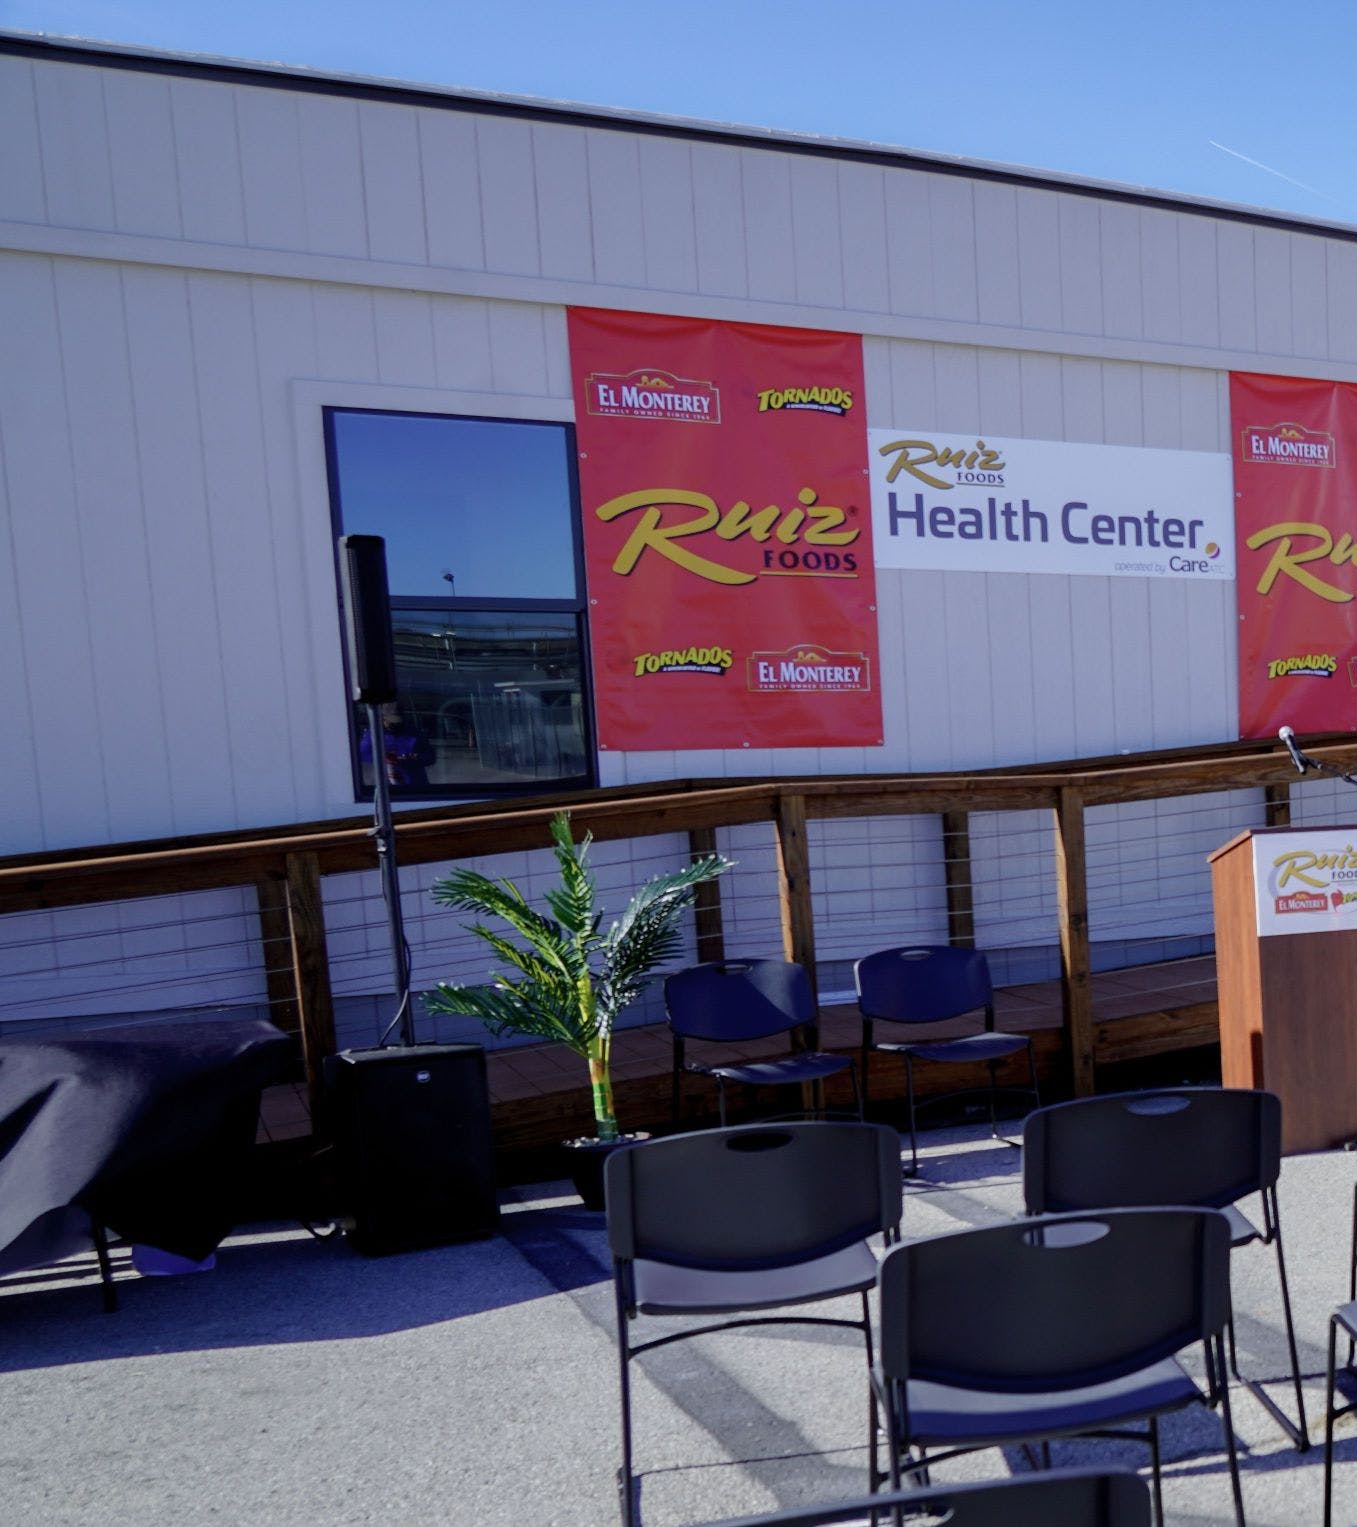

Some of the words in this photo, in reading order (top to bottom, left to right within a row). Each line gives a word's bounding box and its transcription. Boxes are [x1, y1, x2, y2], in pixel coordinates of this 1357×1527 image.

[598, 384, 619, 406] EL
[622, 385, 710, 413] MONTEREY
[758, 386, 853, 412] TORNADOS
[1268, 436, 1330, 459] MONTEREY
[878, 439, 1006, 490] Ruiz
[957, 472, 1005, 485] FOODS
[888, 492, 1049, 543] Health
[1061, 501, 1204, 549] Center
[595, 487, 861, 585] Ruiz
[763, 550, 857, 572] FOODS
[634, 646, 733, 676] TORNADOS
[758, 661, 778, 682] EL
[780, 662, 861, 683] MONTEREY
[1268, 654, 1337, 679] TORNADOS
